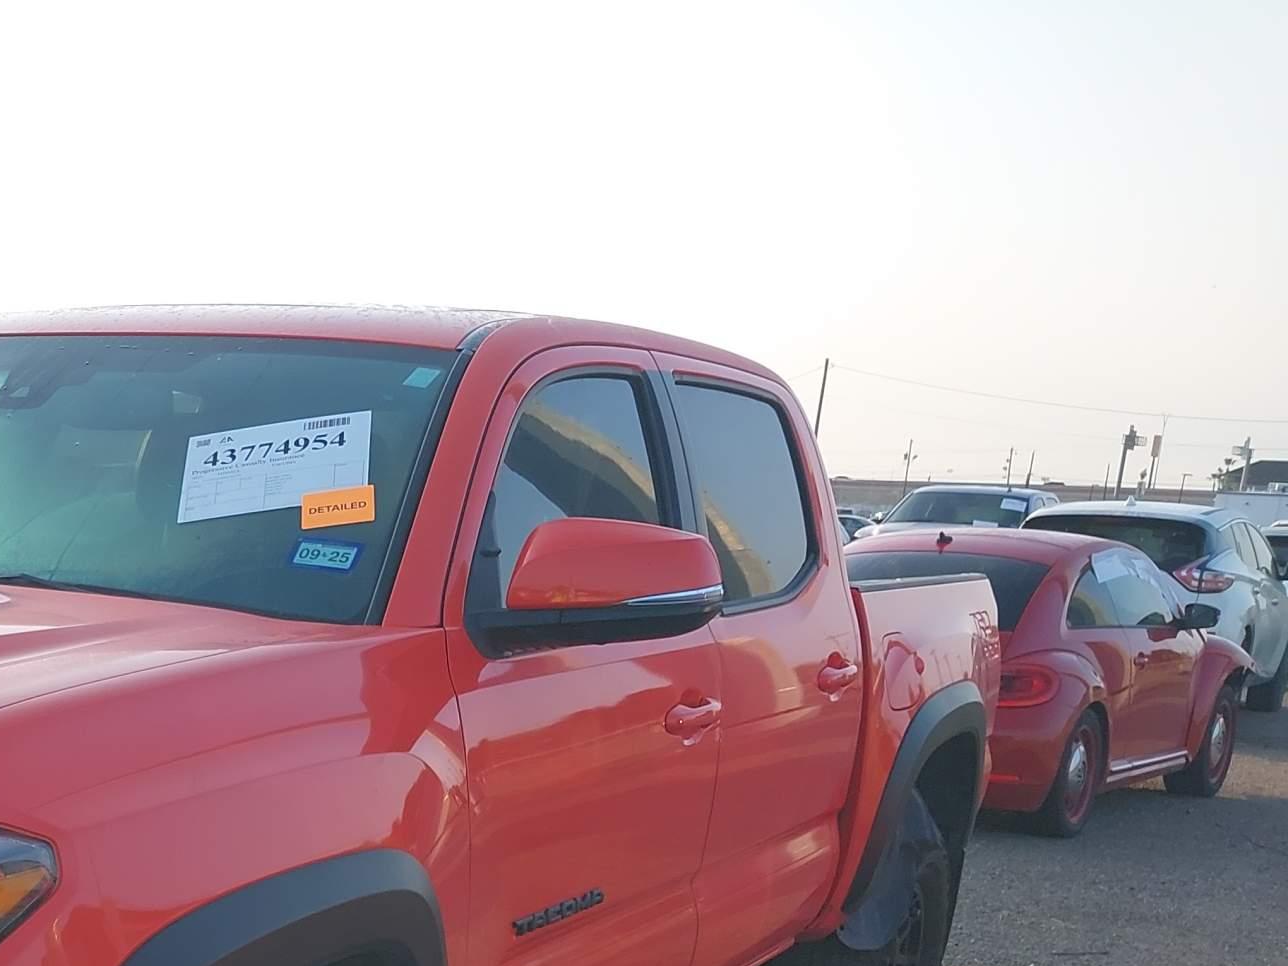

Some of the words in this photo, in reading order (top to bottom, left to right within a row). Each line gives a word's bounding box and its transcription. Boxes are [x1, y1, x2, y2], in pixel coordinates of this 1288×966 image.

[203, 431, 347, 467] 43774954
[308, 500, 367, 515] DETAILED
[299, 547, 321, 560] 09
[327, 550, 351, 564] 25
